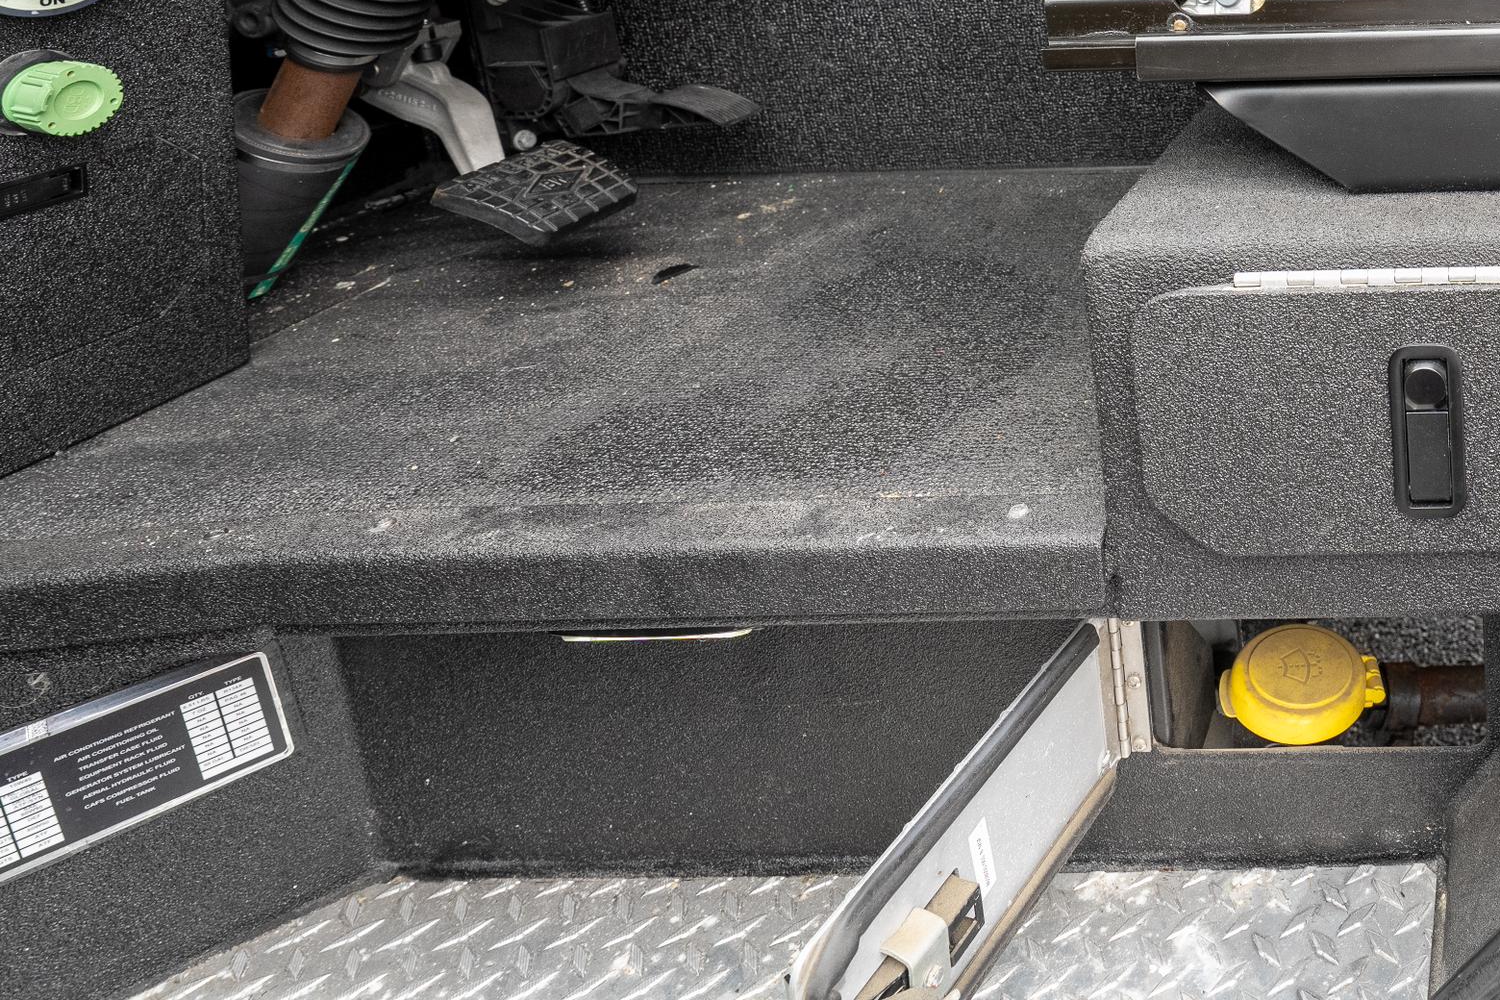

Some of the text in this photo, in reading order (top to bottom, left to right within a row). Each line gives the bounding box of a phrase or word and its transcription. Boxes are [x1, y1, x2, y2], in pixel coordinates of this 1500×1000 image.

[187, 674, 243, 701] QTY. TYPE
[53, 709, 176, 763] AIR CONDITIONING REFRIGERANT
[76, 752, 91, 763] AIR
[91, 731, 145, 758] CONDITIONING
[77, 751, 119, 773] TRANSFER
[118, 742, 141, 756] CASE
[140, 733, 163, 747] FLUID
[6, 769, 28, 784] TYPE
[64, 773, 112, 798] GENERATOR
[112, 760, 144, 778] SYSTEM
[143, 743, 186, 765] LUBRICANT
[78, 759, 123, 782] EQUIPMENT
[122, 750, 146, 764] RACK
[145, 741, 168, 755] FLUID
[81, 756, 176, 801] AERIAL HYDRAULIC FLUID
[105, 774, 159, 802] COMPRESSOR
[158, 764, 181, 779] FLUID
[114, 784, 156, 807] FUEL TANK
